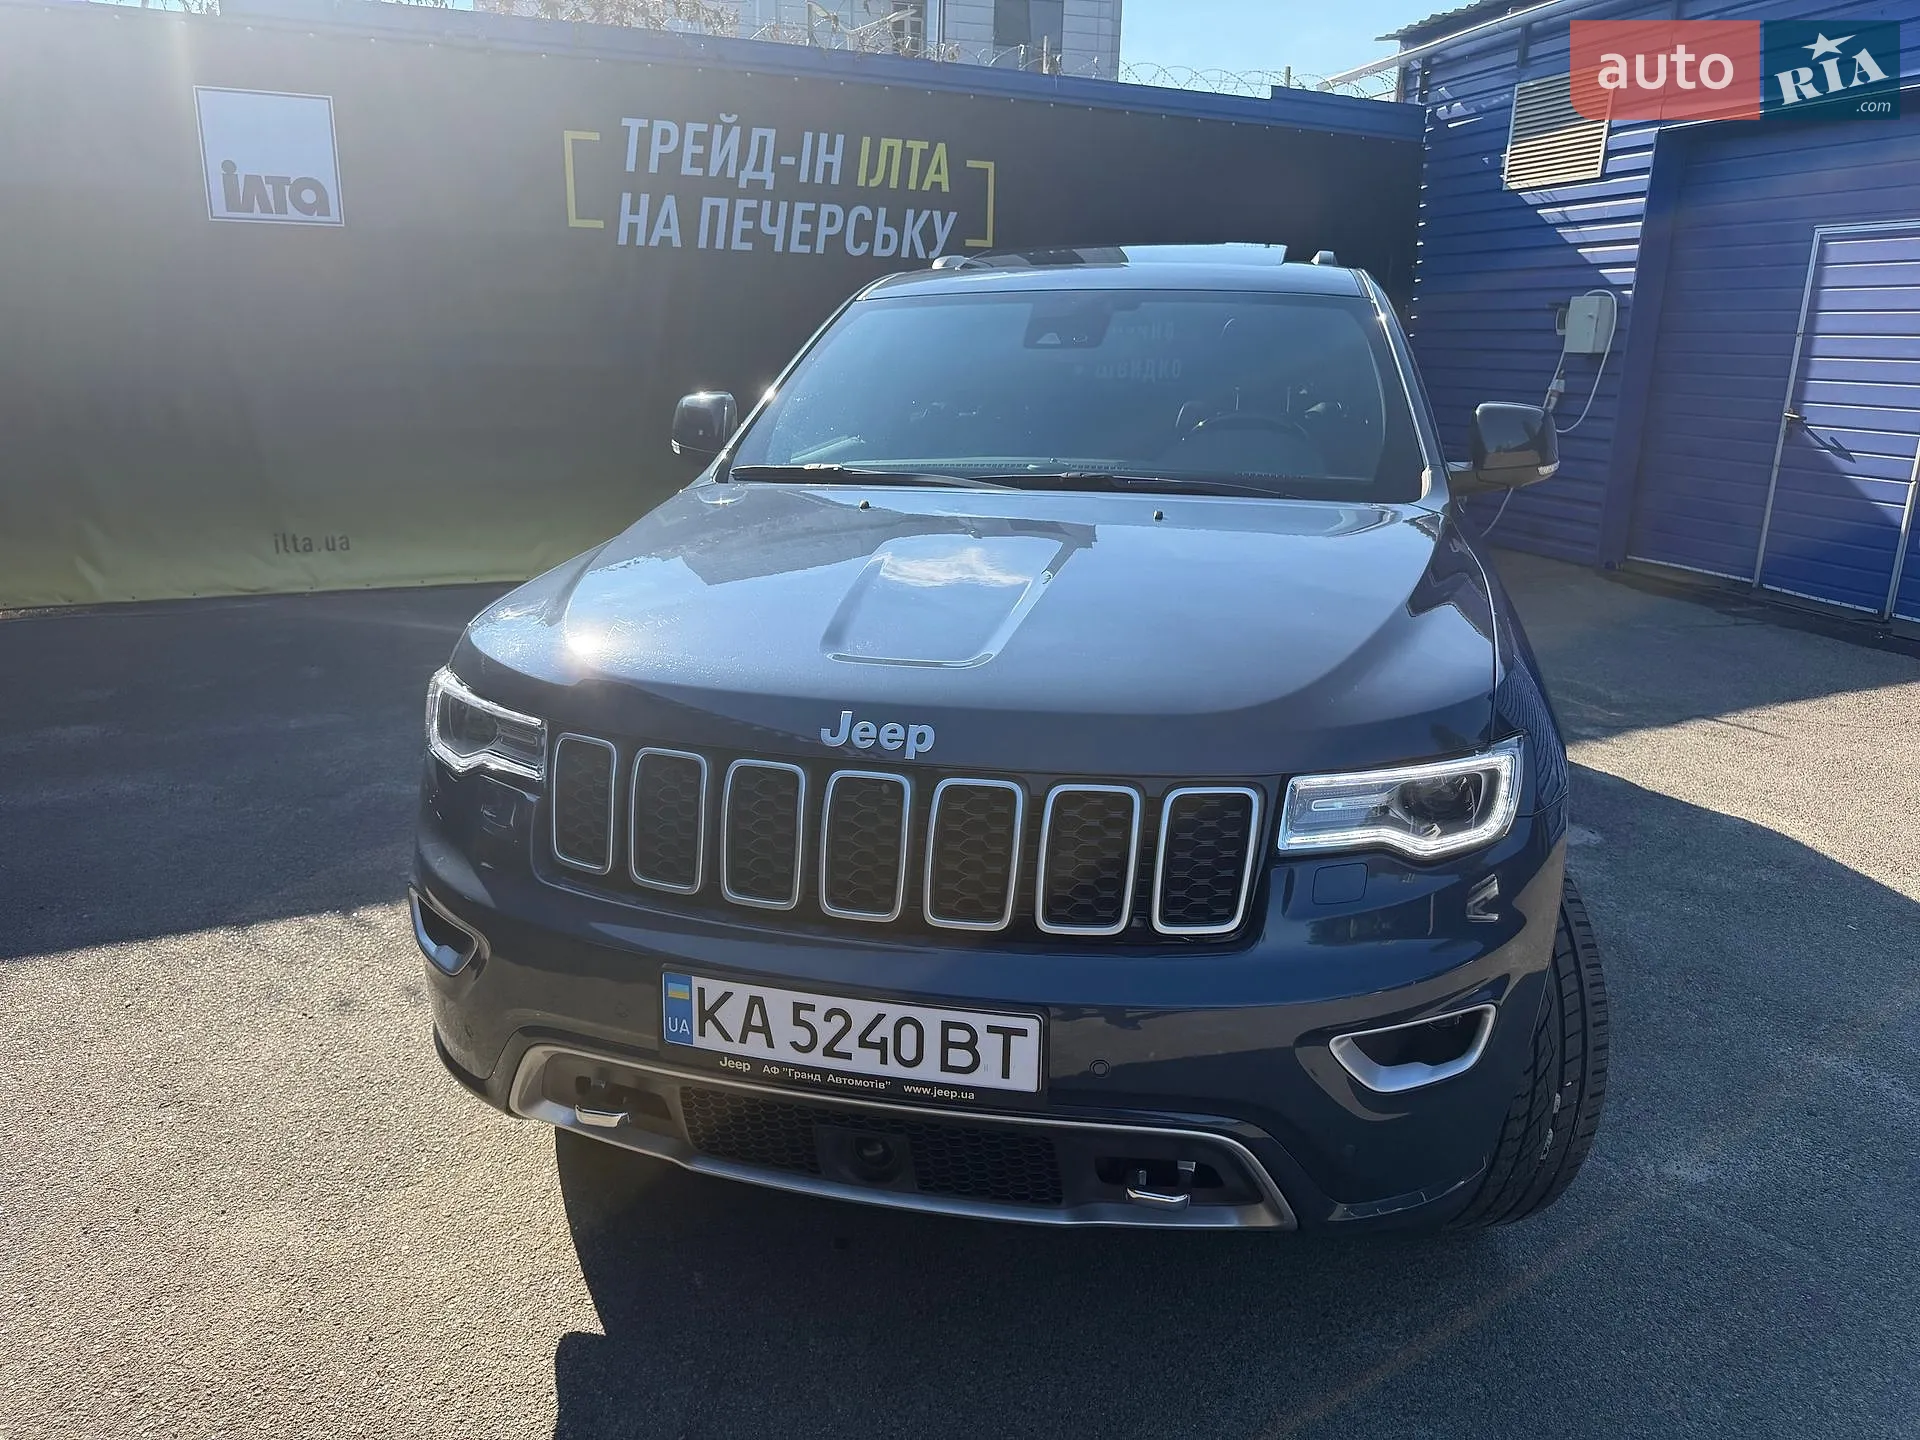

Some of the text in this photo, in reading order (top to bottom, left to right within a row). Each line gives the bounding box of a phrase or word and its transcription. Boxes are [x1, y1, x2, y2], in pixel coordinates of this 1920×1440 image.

[621, 113, 950, 193] ТРЕЙД-ІН ІЛТА
[616, 192, 958, 260] НА ПЕЧЕРСЬКУ
[273, 533, 350, 554] ilta.ua
[820, 710, 935, 760] Jeep
[668, 1016, 690, 1035] UA
[697, 986, 1028, 1080] KA 5240 BT
[720, 1057, 751, 1072] Jeep
[762, 1064, 780, 1075] АФ
[903, 1085, 975, 1100] www.jeep.ua
